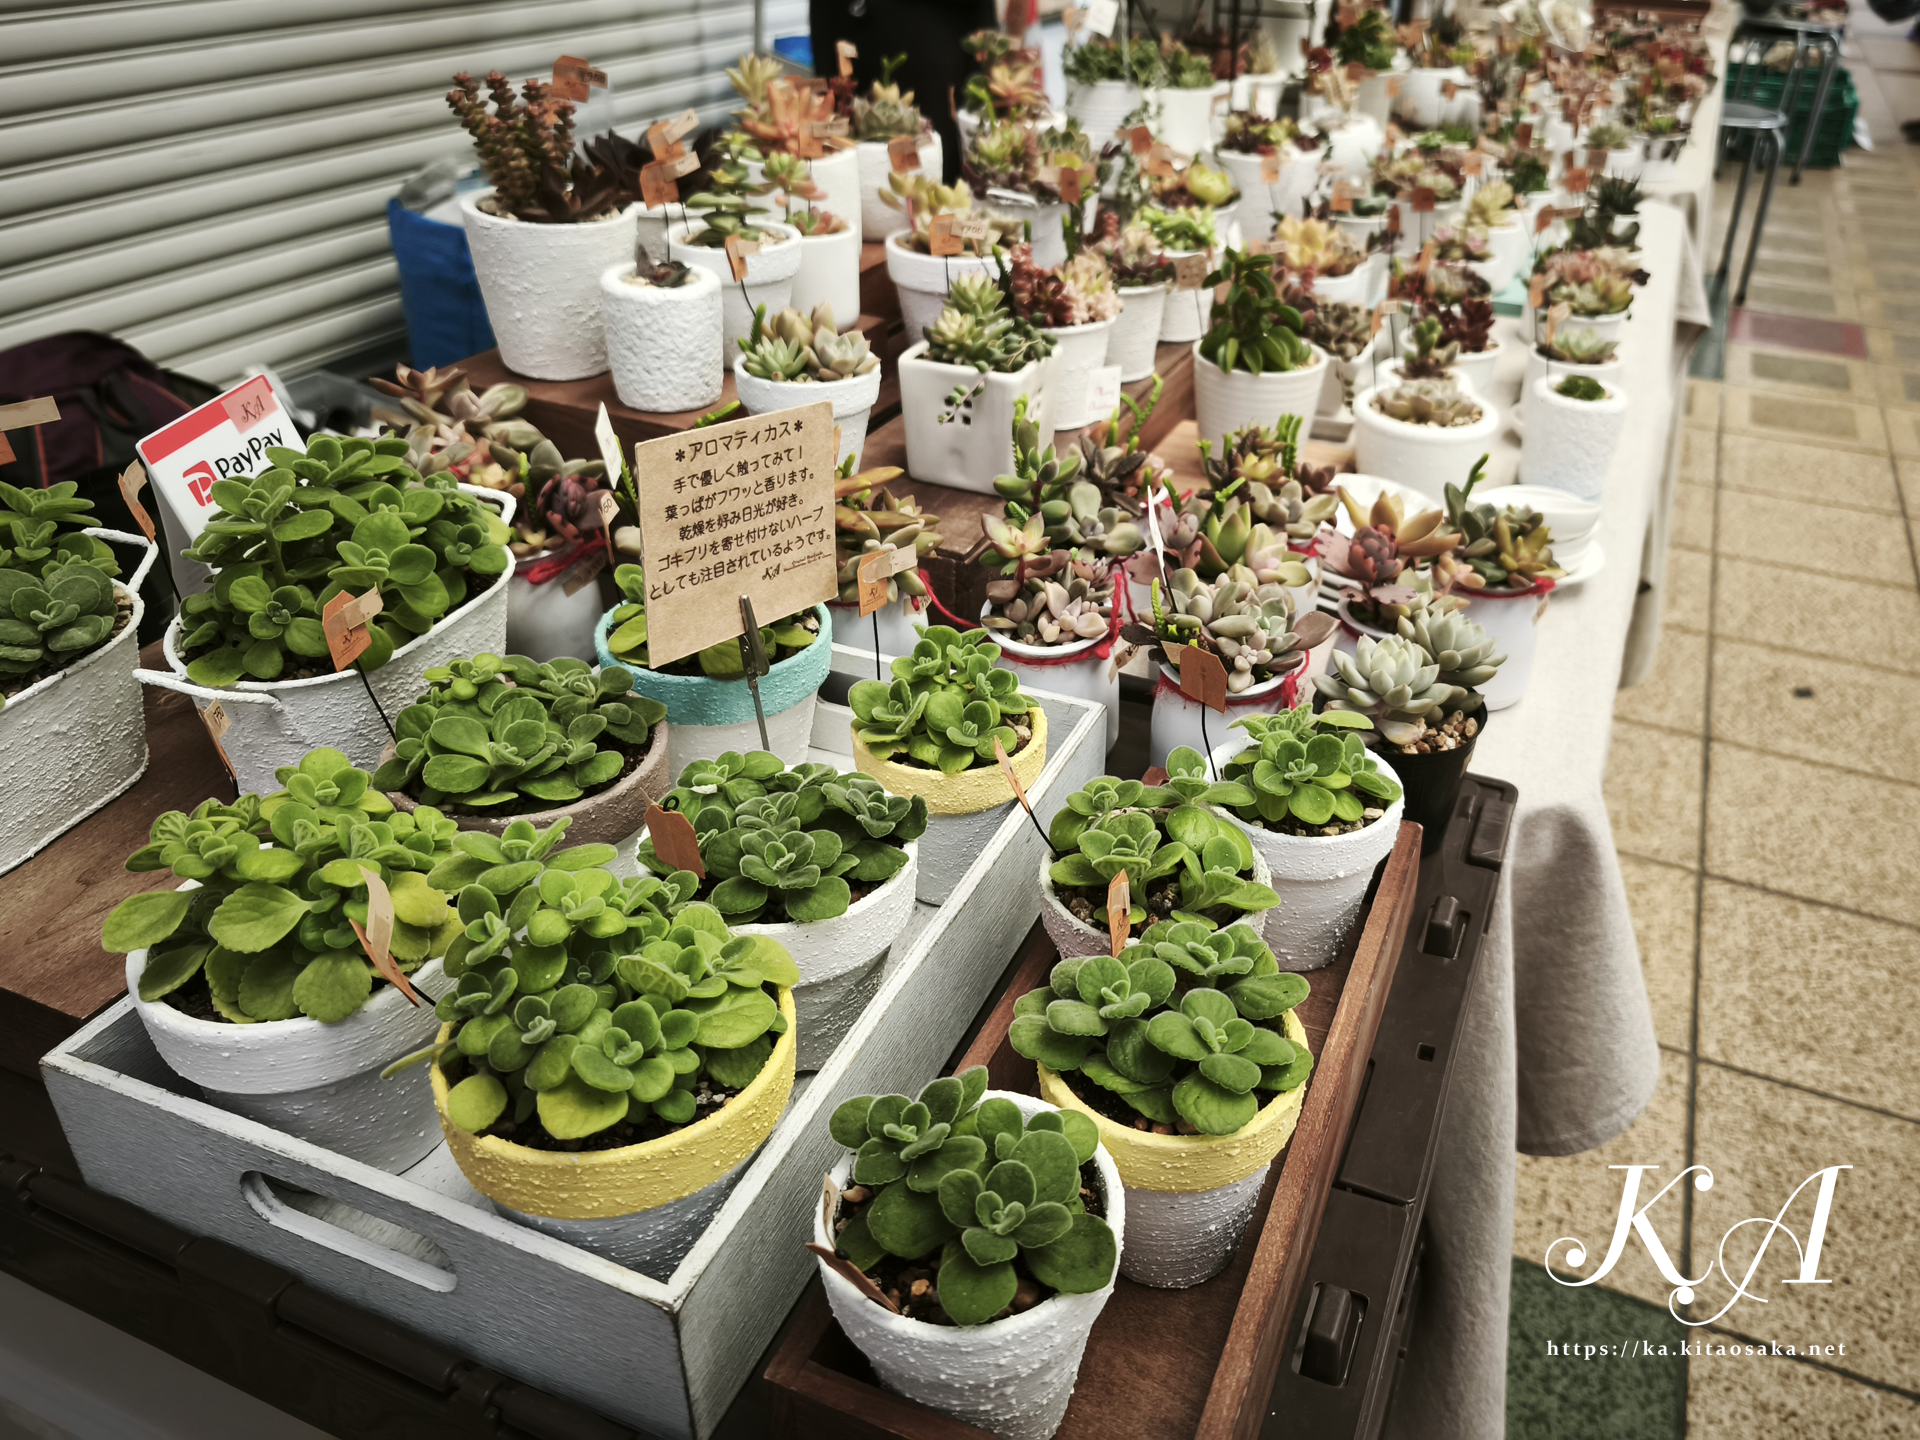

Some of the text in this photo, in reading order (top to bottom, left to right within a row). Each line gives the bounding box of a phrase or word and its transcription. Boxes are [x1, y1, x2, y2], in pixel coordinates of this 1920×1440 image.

[240, 394, 266, 423] KA
[678, 493, 804, 542] 乾燥を好み日光が好き。
[650, 528, 832, 601] としても注目されているようです。
